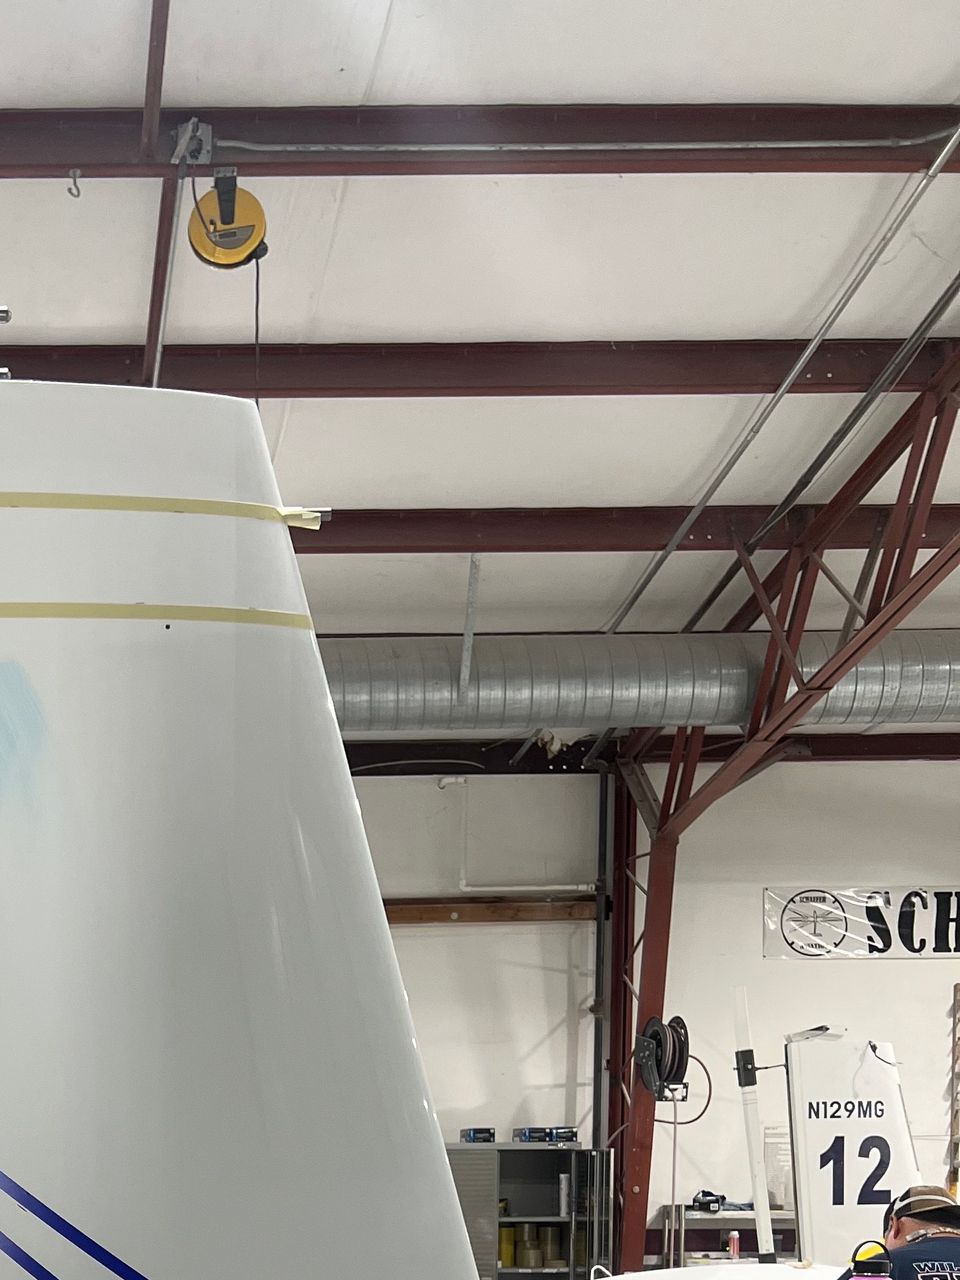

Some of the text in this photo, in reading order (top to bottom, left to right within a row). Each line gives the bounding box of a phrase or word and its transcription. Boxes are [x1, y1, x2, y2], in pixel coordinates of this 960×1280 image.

[866, 891, 960, 954] SCH
[808, 1100, 884, 1119] N129MG
[820, 1135, 891, 1206] 12
